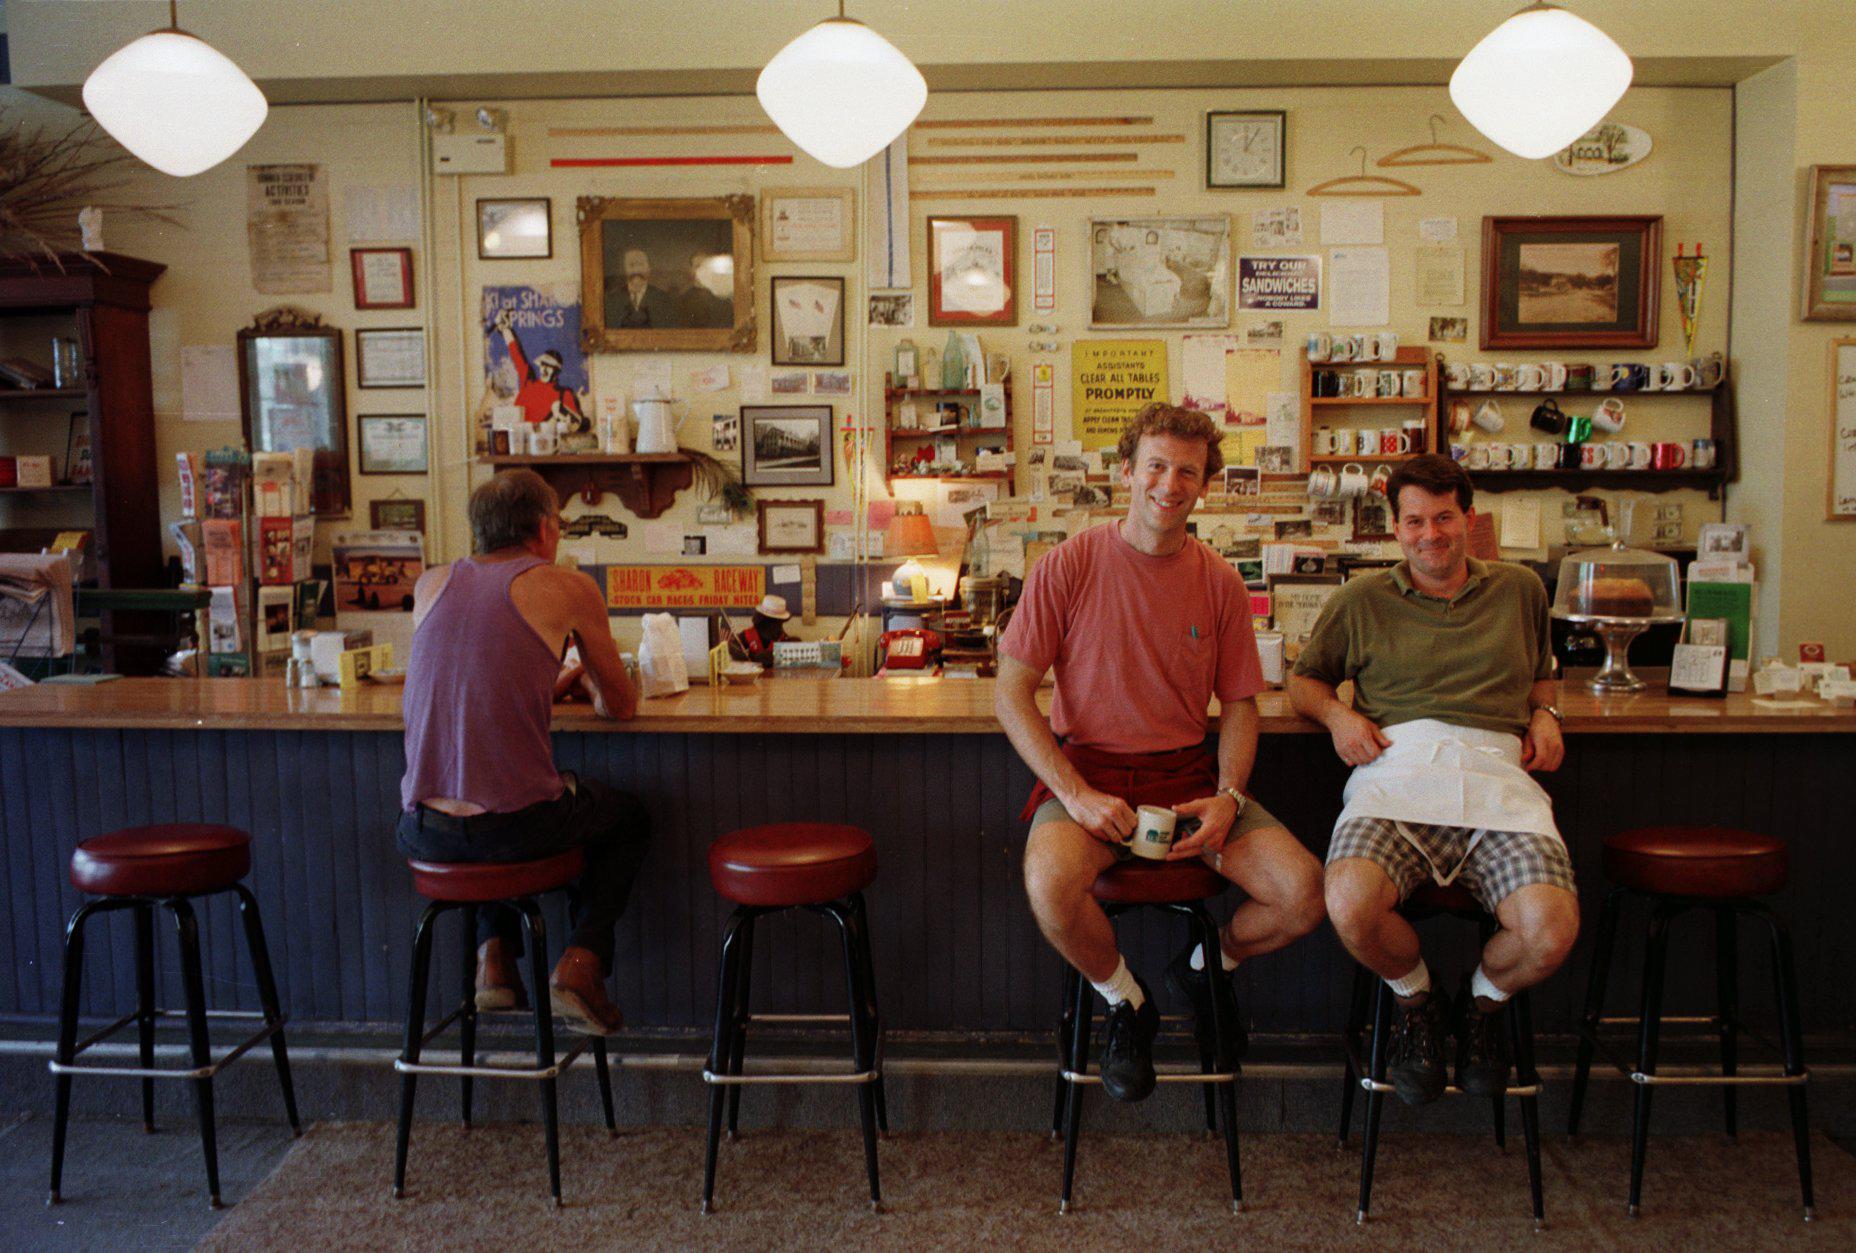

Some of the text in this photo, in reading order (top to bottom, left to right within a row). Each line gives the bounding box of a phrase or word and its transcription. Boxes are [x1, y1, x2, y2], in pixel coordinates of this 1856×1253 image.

[1251, 261, 1307, 270] TRY OUR
[1242, 276, 1316, 294] SANDWICHES
[501, 309, 565, 328] SPRINGS
[1080, 373, 1160, 384] CLEAR ALL TABLES
[1085, 387, 1156, 400] PROMPTLY
[612, 569, 759, 593] SHARON RACEWAY
[613, 595, 760, 605] STOCK CAR RACES FRIDAY NITES
